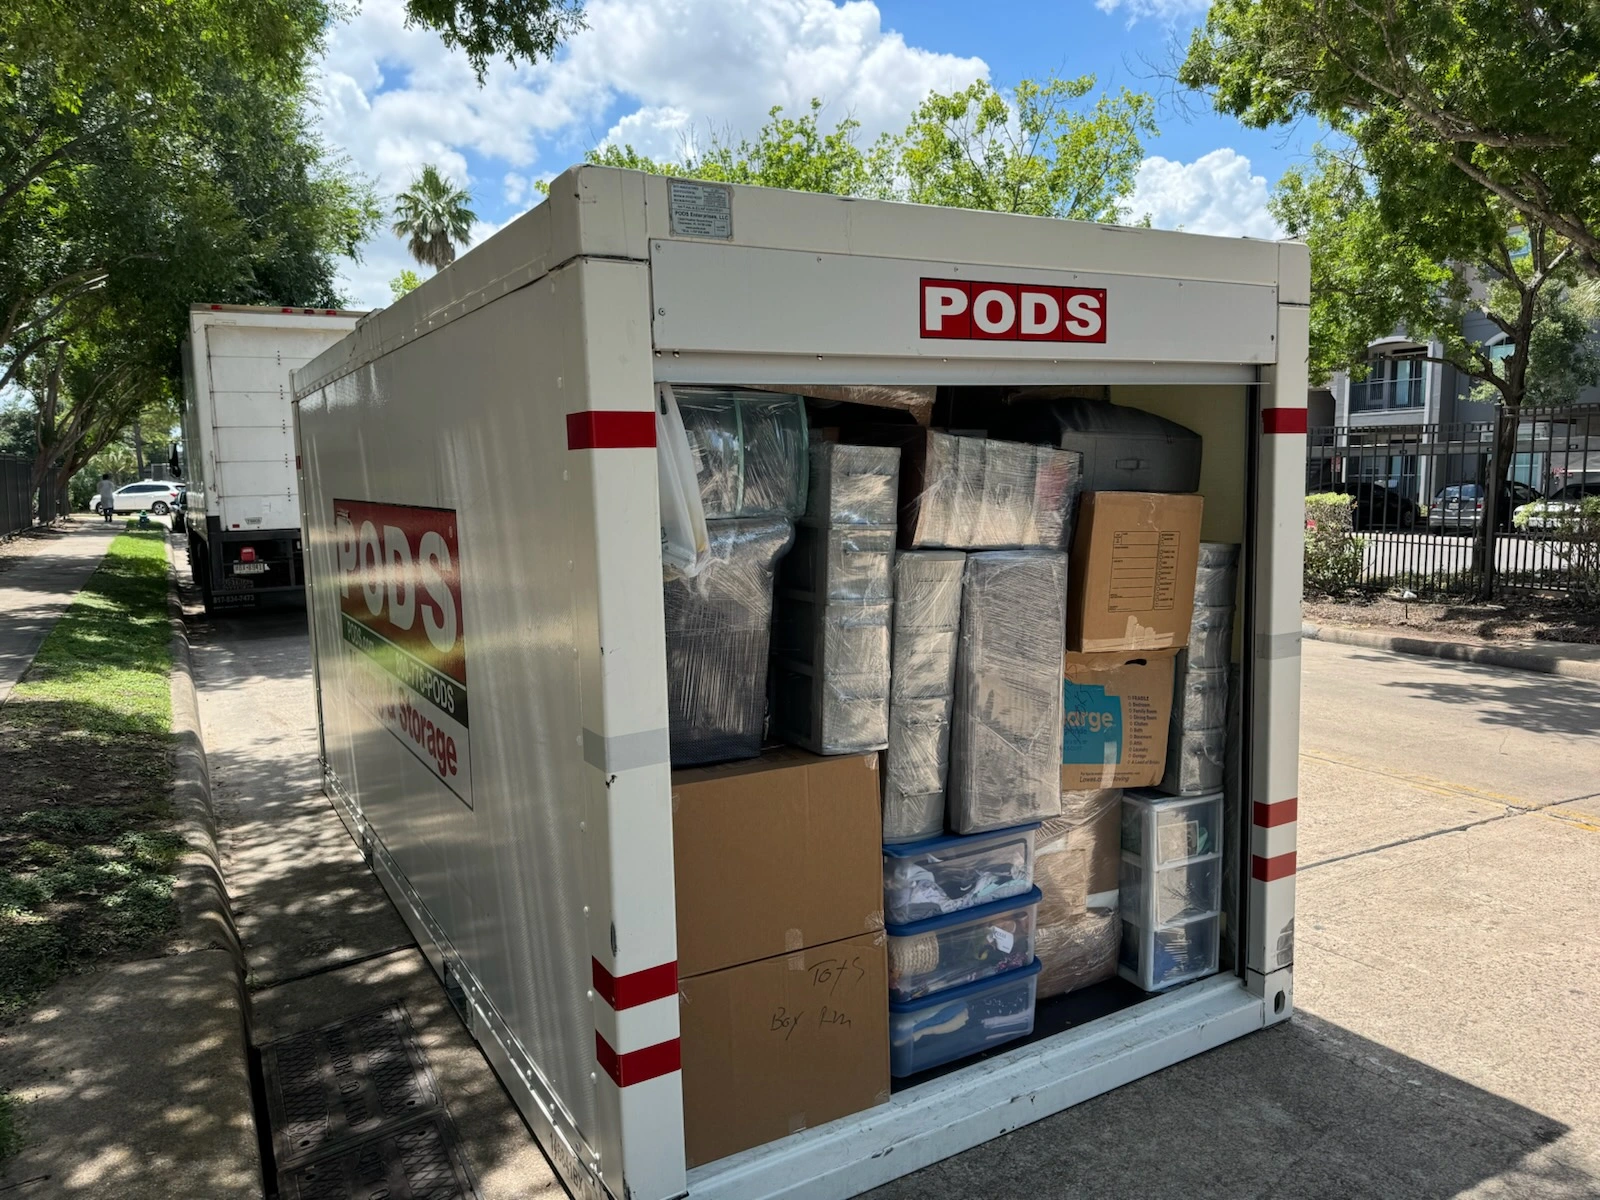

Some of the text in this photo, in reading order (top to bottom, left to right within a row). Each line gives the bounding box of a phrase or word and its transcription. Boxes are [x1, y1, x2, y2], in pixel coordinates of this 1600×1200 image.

[924, 286, 1101, 337] PODS
[337, 515, 457, 653] PODS
[399, 684, 457, 778] Storage
[1064, 711, 1113, 732] arge
